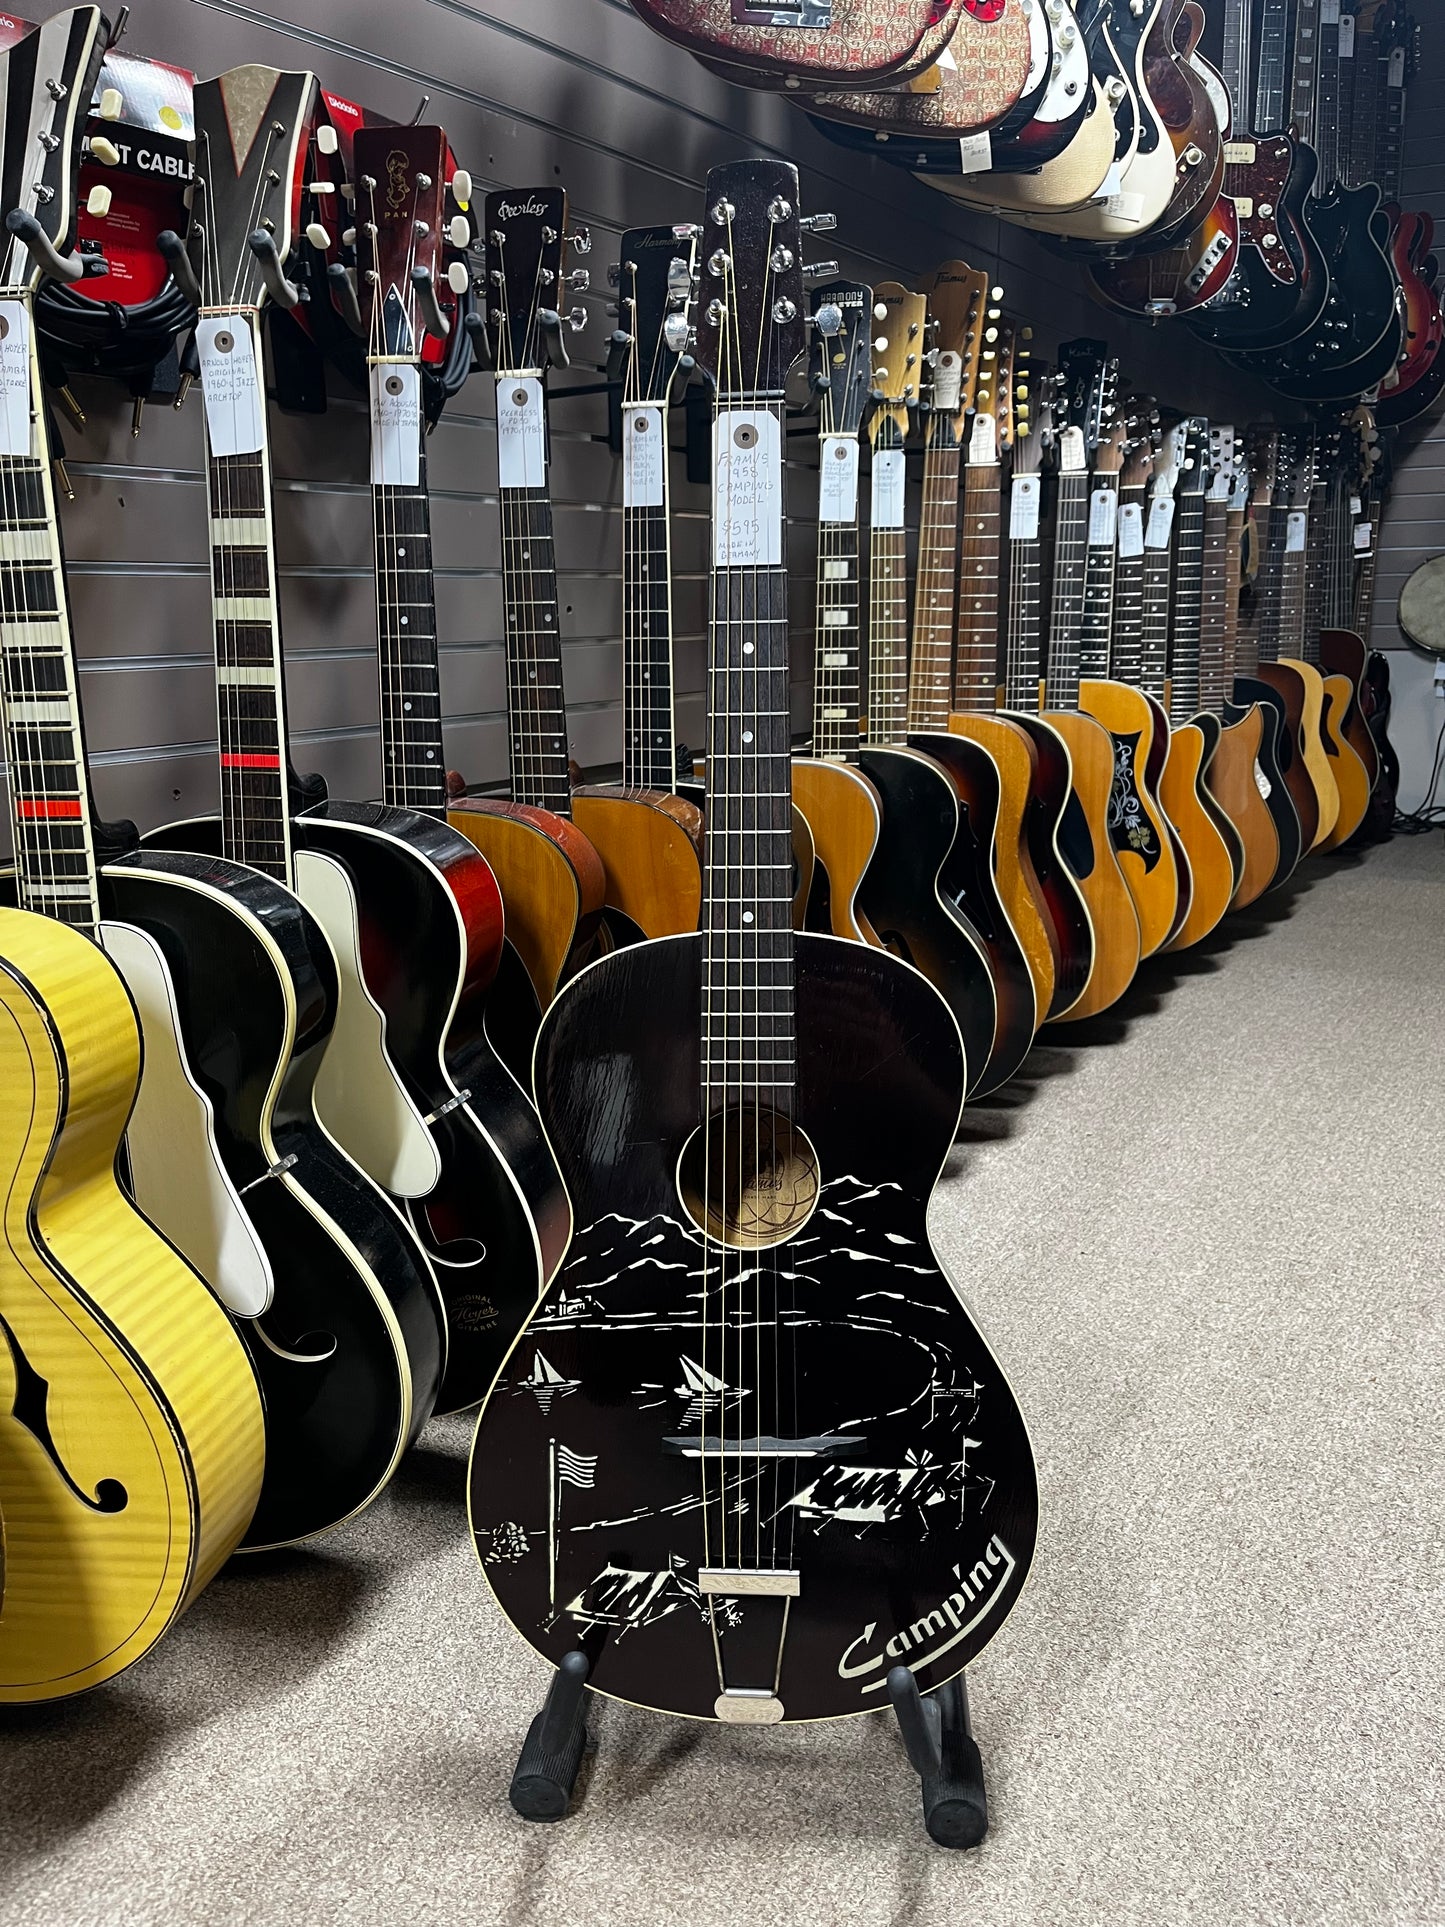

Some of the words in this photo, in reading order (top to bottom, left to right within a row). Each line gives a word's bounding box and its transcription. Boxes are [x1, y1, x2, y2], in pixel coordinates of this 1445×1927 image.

[384, 211, 408, 219] PAN
[498, 195, 549, 221] Peerless
[633, 234, 684, 249] Harmony
[821, 291, 864, 302] HARMONY
[4, 343, 28, 354] HOYER
[202, 359, 230, 368] ARNOLD
[208, 367, 246, 377] ORIGINAL
[235, 377, 256, 387] JAZZ
[207, 392, 243, 402] ARCHTOP
[718, 451, 769, 468] FRAMUS
[717, 480, 775, 494] CAMPING
[726, 493, 765, 507] MODEL
[721, 518, 761, 537] $595
[720, 547, 761, 561] GERMANY
[838, 1534, 1016, 1690] Camping
